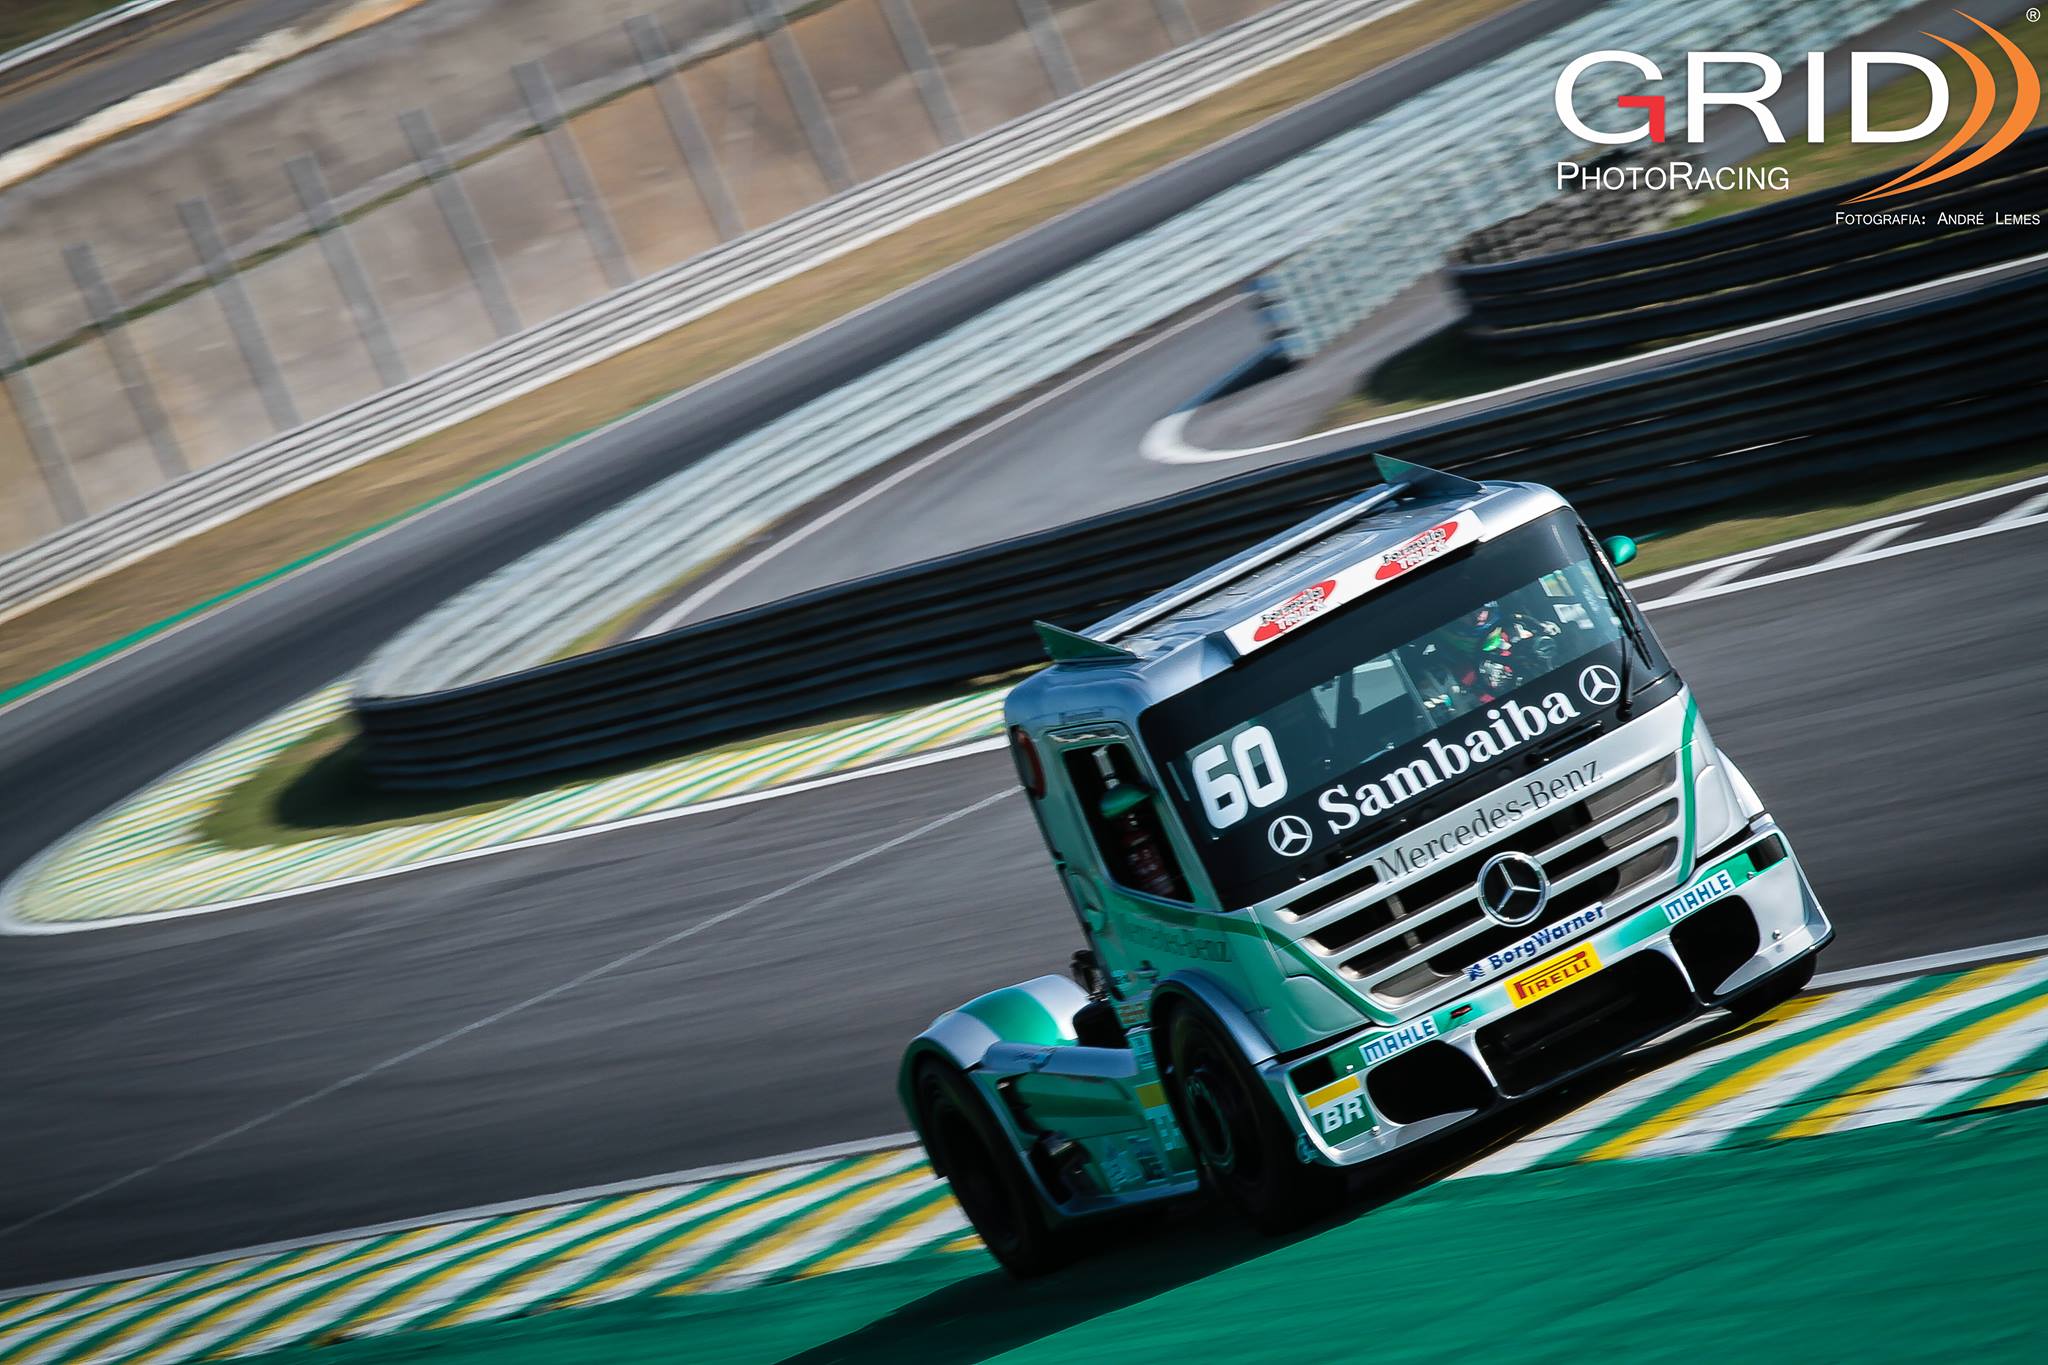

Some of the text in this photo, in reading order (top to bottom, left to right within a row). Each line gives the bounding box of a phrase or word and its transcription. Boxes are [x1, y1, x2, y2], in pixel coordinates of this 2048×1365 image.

[1192, 725, 1288, 829] 60
[1317, 690, 1580, 835] Sambaiba
[1376, 760, 1603, 883] Mercedes-Benz
[1665, 873, 1731, 920] MAHLE
[1488, 906, 1603, 970] BorgWarner
[1513, 951, 1591, 1000] PIRELLI
[1364, 1019, 1434, 1062] MAHLE
[1322, 1096, 1366, 1134] BR
